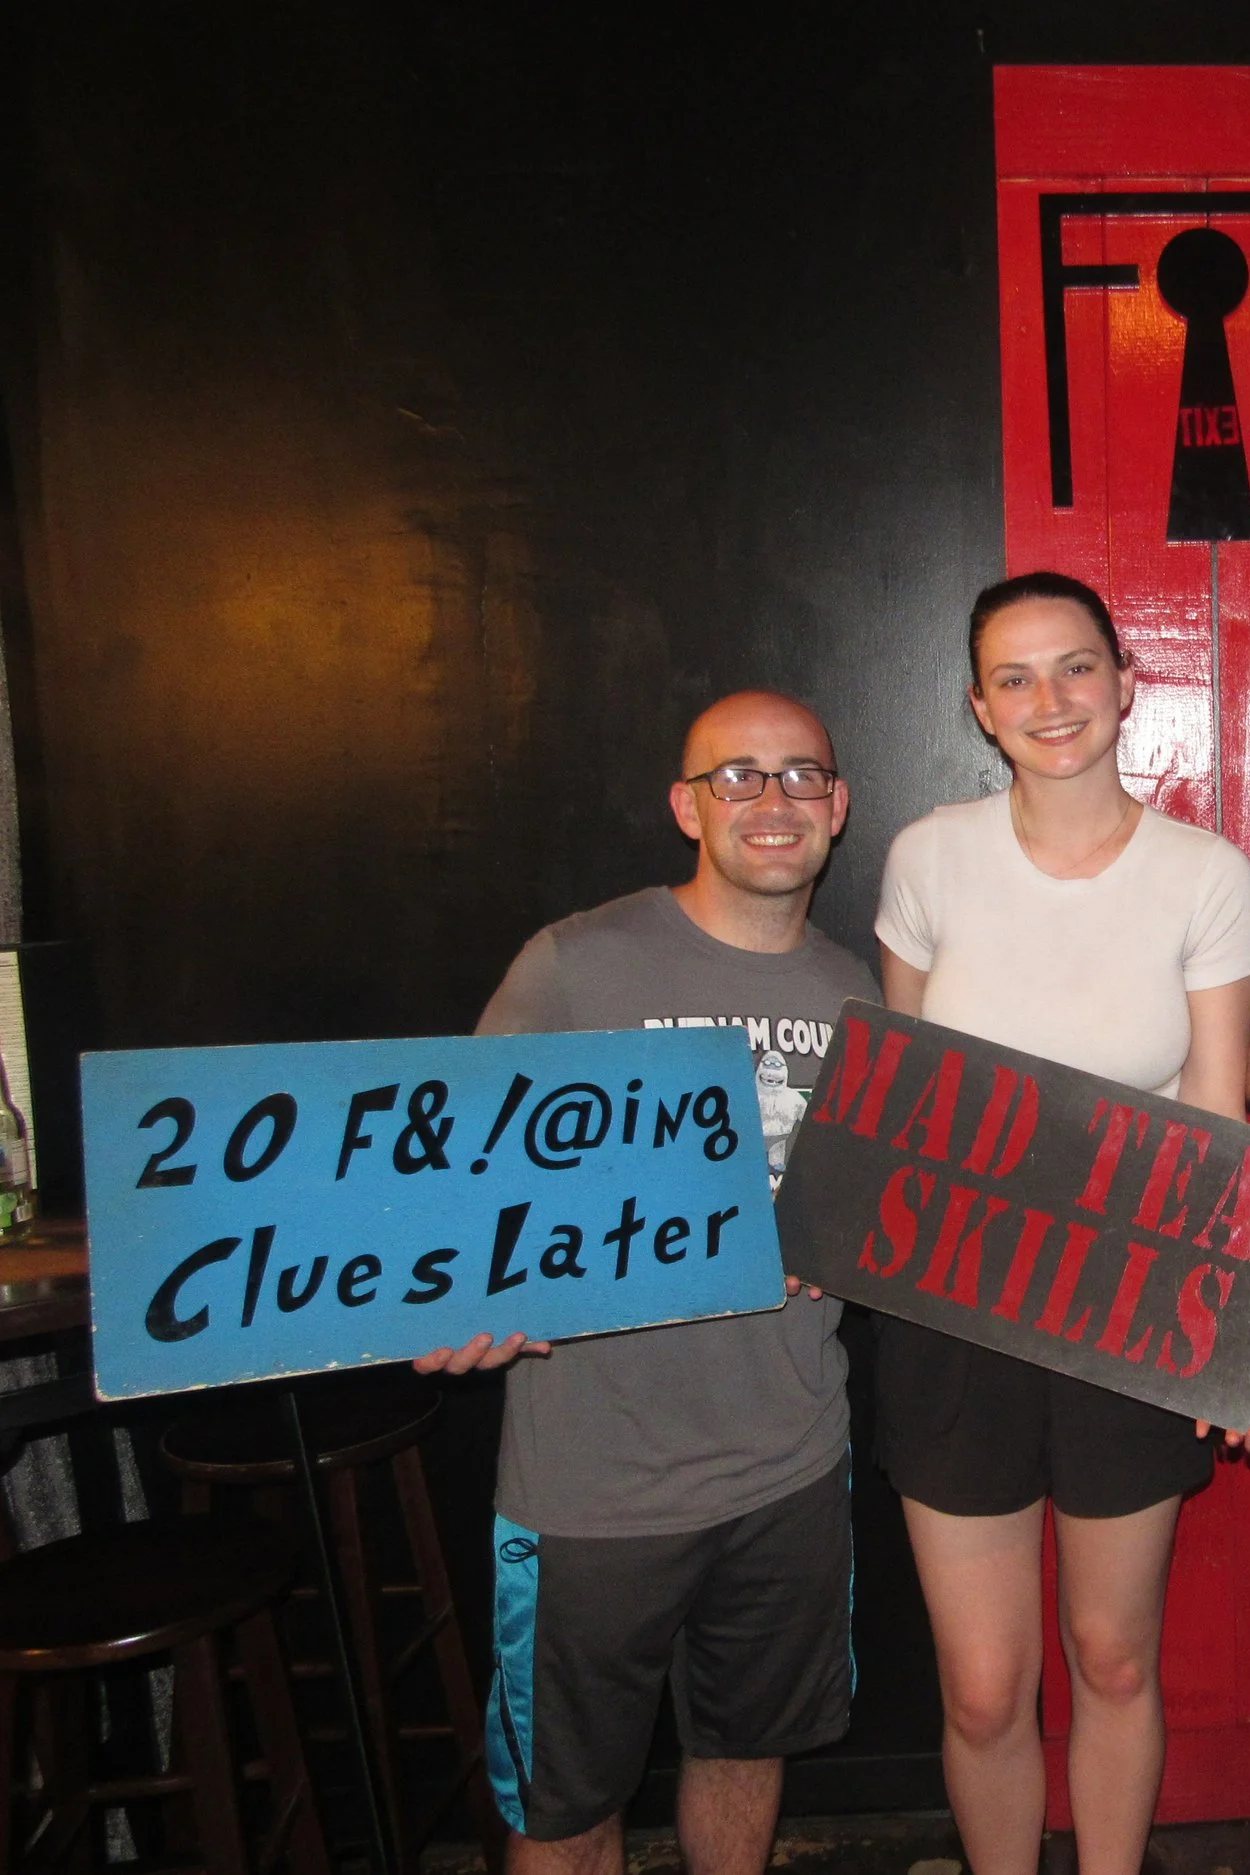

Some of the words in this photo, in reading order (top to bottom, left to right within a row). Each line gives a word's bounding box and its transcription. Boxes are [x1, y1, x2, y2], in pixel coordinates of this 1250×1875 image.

[136, 1092, 299, 1190] 20
[811, 1016, 1039, 1179] MAD
[144, 1224, 460, 1343] Clues
[485, 1196, 740, 1297] Later
[856, 1165, 1236, 1379] SKILLS
